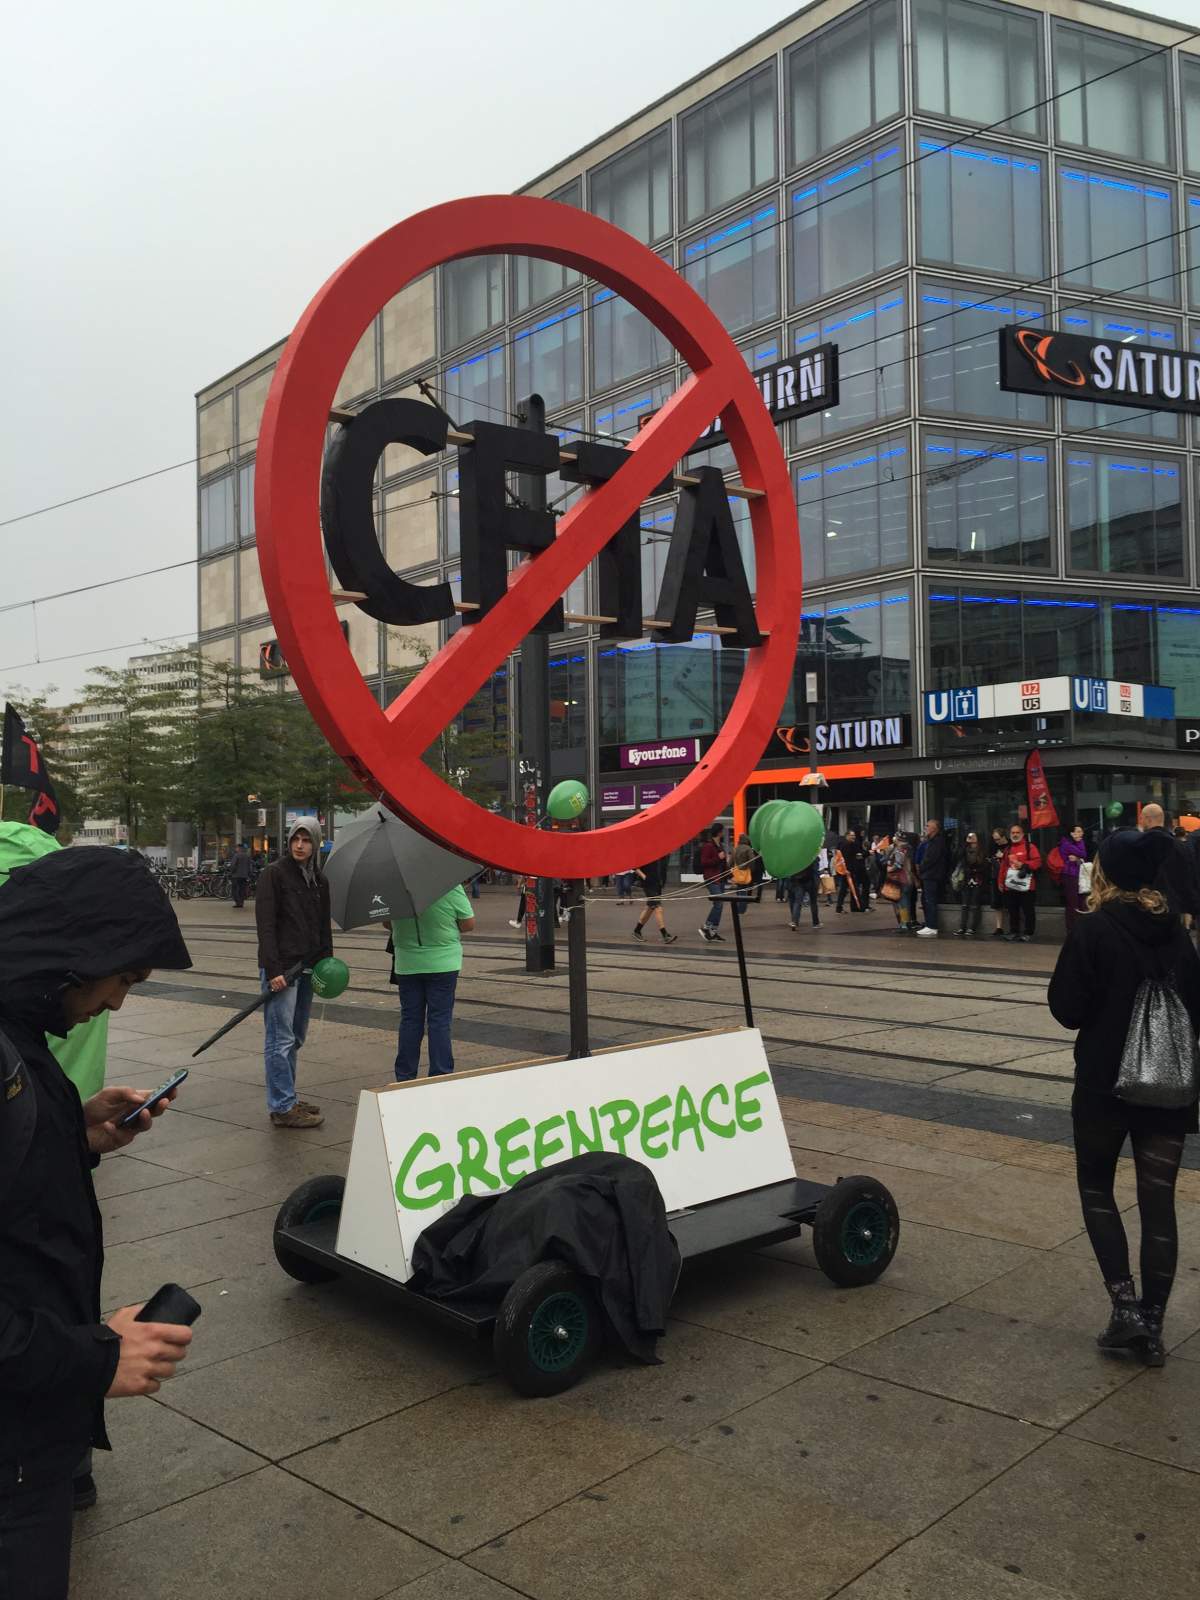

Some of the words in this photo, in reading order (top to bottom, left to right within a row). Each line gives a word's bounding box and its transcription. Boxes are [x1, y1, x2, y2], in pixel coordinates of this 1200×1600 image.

[321, 396, 762, 648] CETA
[1023, 684, 1039, 695] U2
[1074, 678, 1088, 709] U
[928, 692, 949, 721] U
[1023, 699, 1040, 710] U5
[815, 717, 900, 751] SATURN
[633, 745, 687, 764] yourfone
[934, 759, 942, 770] U
[395, 1071, 770, 1210] GREENPEACE
